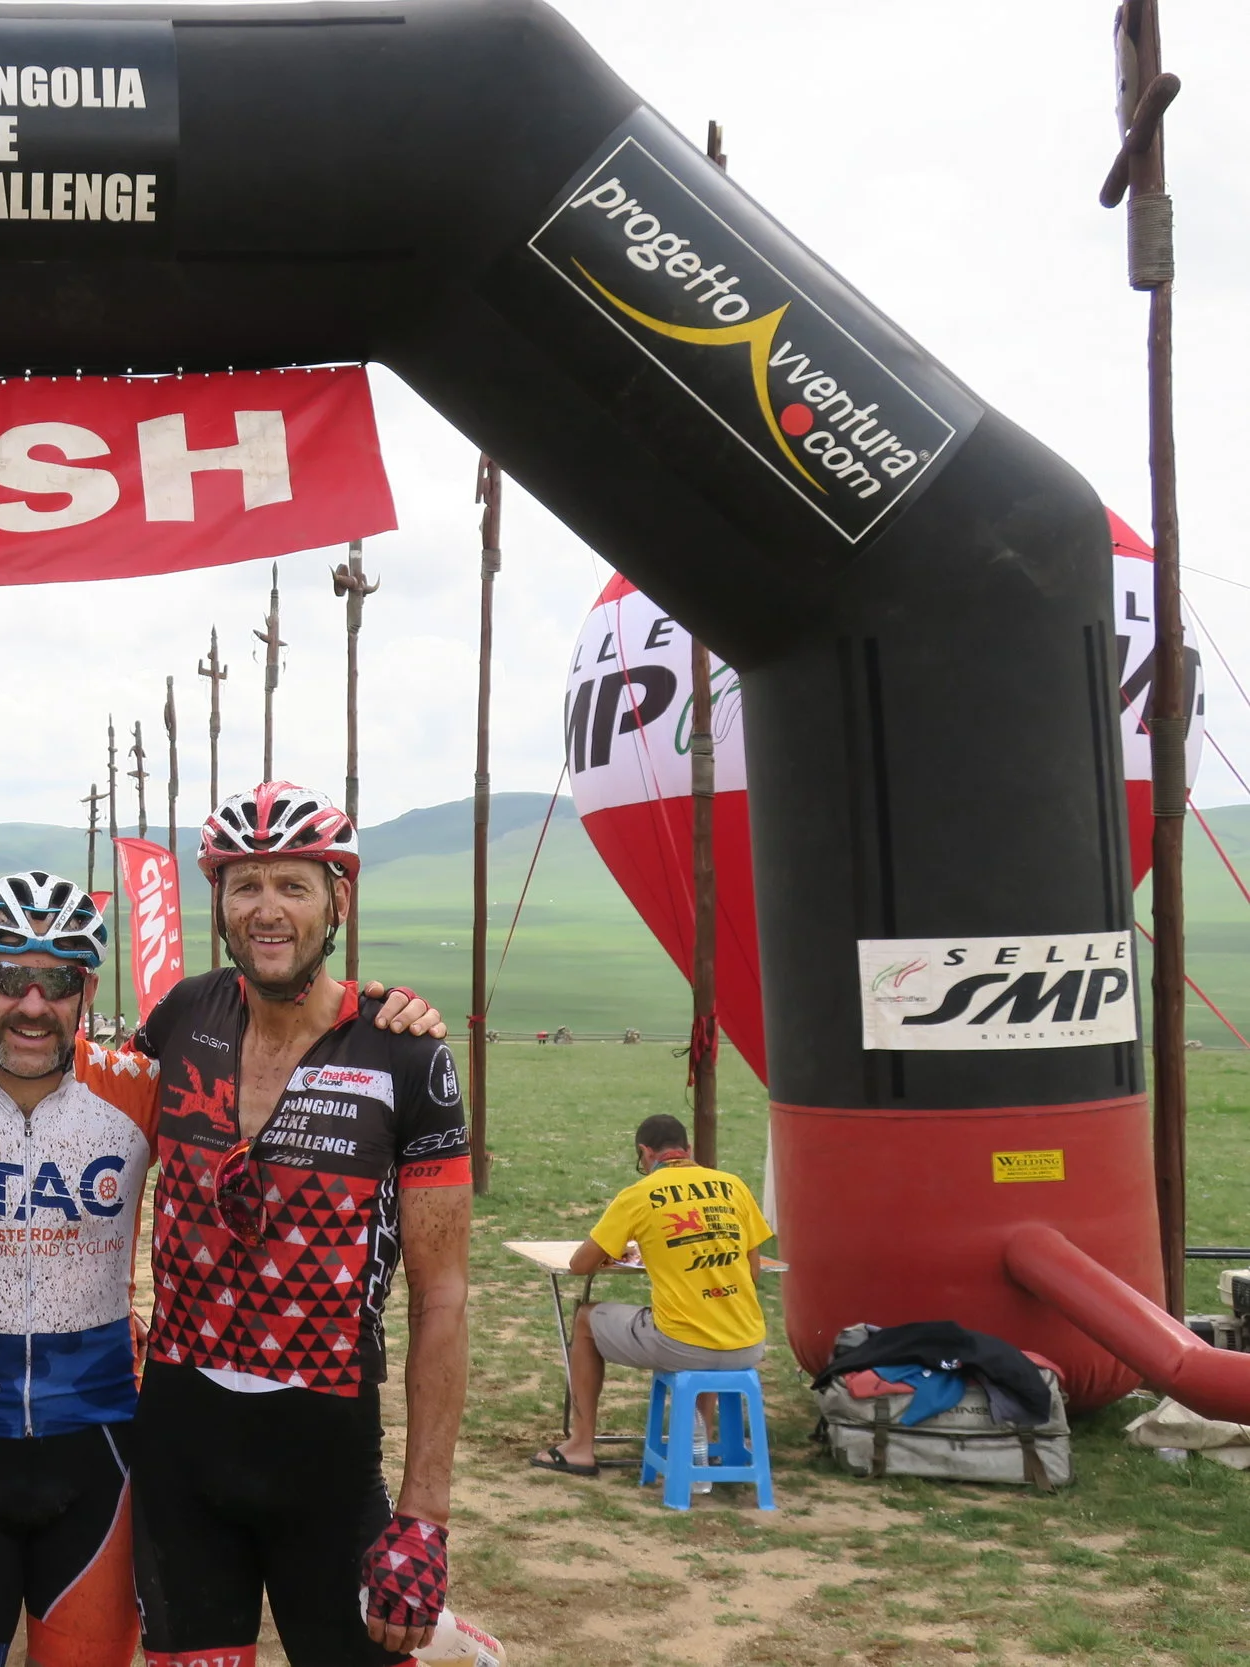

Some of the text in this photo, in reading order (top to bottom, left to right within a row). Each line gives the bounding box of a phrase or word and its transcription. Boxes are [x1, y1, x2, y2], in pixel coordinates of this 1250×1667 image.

[570, 177, 750, 322] progetto
[573, 616, 676, 675] LLE
[943, 941, 1127, 966] SELLE
[901, 967, 1129, 1026] SMP
[981, 1032, 1045, 1040] SINCE
[318, 1079, 344, 1087] RACING
[320, 1070, 374, 1085] matador
[281, 1097, 358, 1119] MONGOLIA
[261, 1130, 358, 1156] CHALLENGE
[264, 1154, 314, 1167] SMP
[996, 1156, 1060, 1166] WELDING
[404, 1165, 443, 1178] 2017
[649, 1180, 734, 1210] STAFF
[22, 1244, 59, 1257] AND
[65, 1236, 125, 1256] CYCLING
[685, 1251, 740, 1272] SMP
